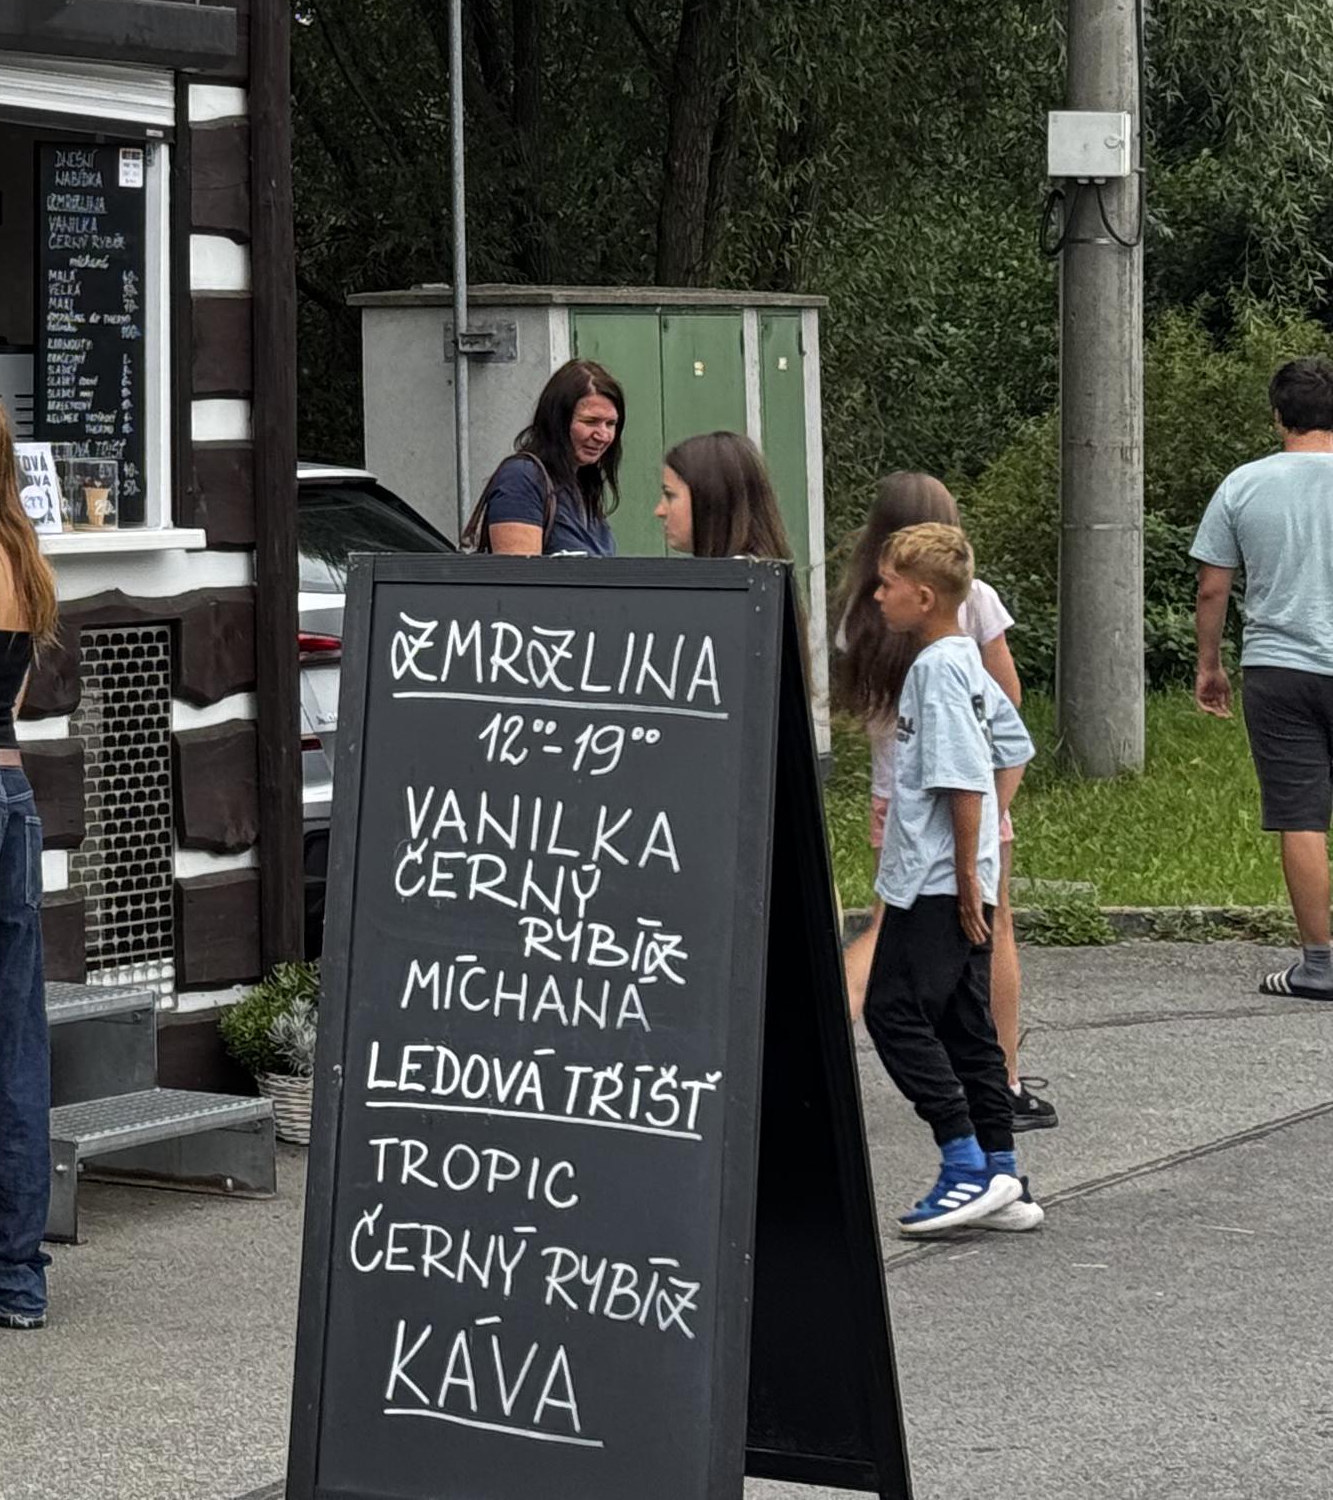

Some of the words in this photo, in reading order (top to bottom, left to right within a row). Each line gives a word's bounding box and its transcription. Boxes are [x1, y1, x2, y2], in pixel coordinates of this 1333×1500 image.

[48, 215, 98, 233] VANILKA
[390, 612, 721, 704] ZMRZLINA
[407, 786, 680, 873] VANILKA
[395, 836, 601, 916] ČERNÝ
[518, 918, 688, 984] RYBÍZ
[401, 954, 658, 1032] MÍCHANÁ
[366, 1041, 556, 1112] LEDOVÁ
[564, 1062, 722, 1130] TŘÍŠŤ
[368, 1137, 579, 1209] TROPIC
[350, 1204, 538, 1296] ČERNÝ
[541, 1246, 701, 1339] RYBÍZ
[386, 1316, 581, 1434] KÁVA
